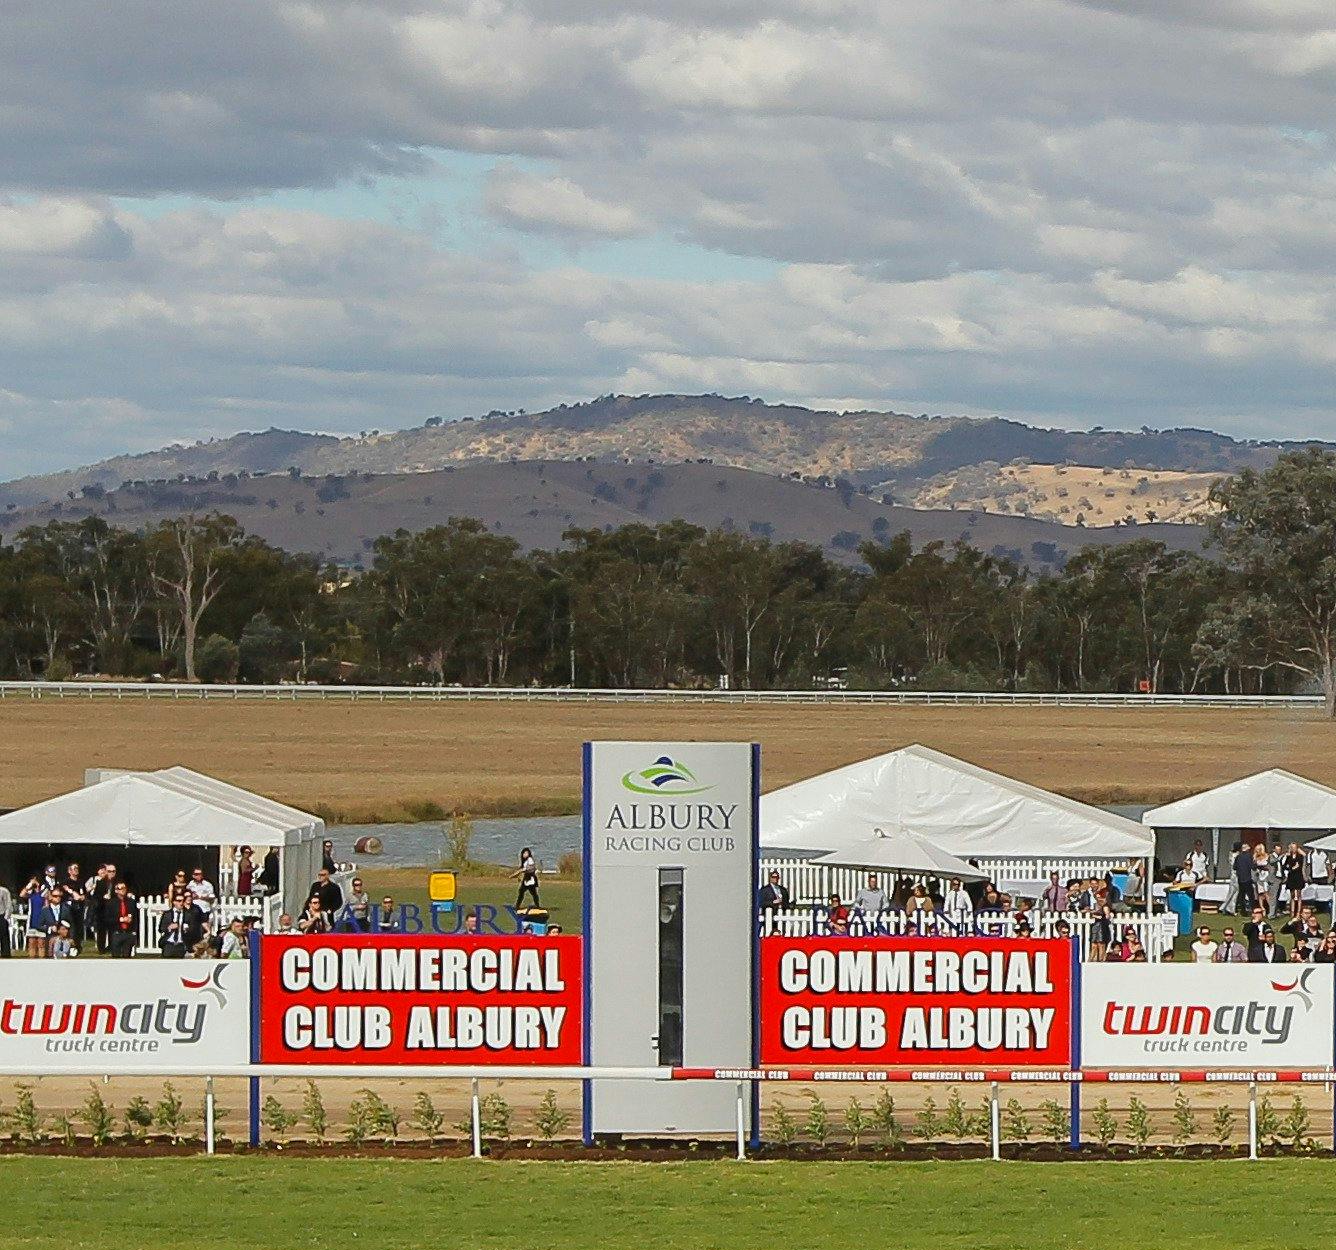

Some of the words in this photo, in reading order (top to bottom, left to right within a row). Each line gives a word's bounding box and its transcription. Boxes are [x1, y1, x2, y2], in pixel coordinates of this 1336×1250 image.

[605, 803, 738, 830] ALBURY
[605, 836, 682, 852] RACING
[687, 836, 736, 852] CLUB
[334, 902, 524, 935] ALBURY
[281, 947, 565, 992] COMMERCIAL
[780, 948, 1054, 994] COMMERCIAL
[0, 998, 207, 1045] twincity
[283, 1005, 393, 1050] CLUB
[405, 1005, 567, 1050] ALBURY
[782, 1006, 888, 1051] CLUB
[900, 1006, 1055, 1051] ALBURY
[1102, 1000, 1294, 1045] twincity
[45, 1036, 95, 1053] truck
[99, 1036, 159, 1053] centre
[1142, 1036, 1190, 1053] truck
[1193, 1036, 1248, 1053] centre
